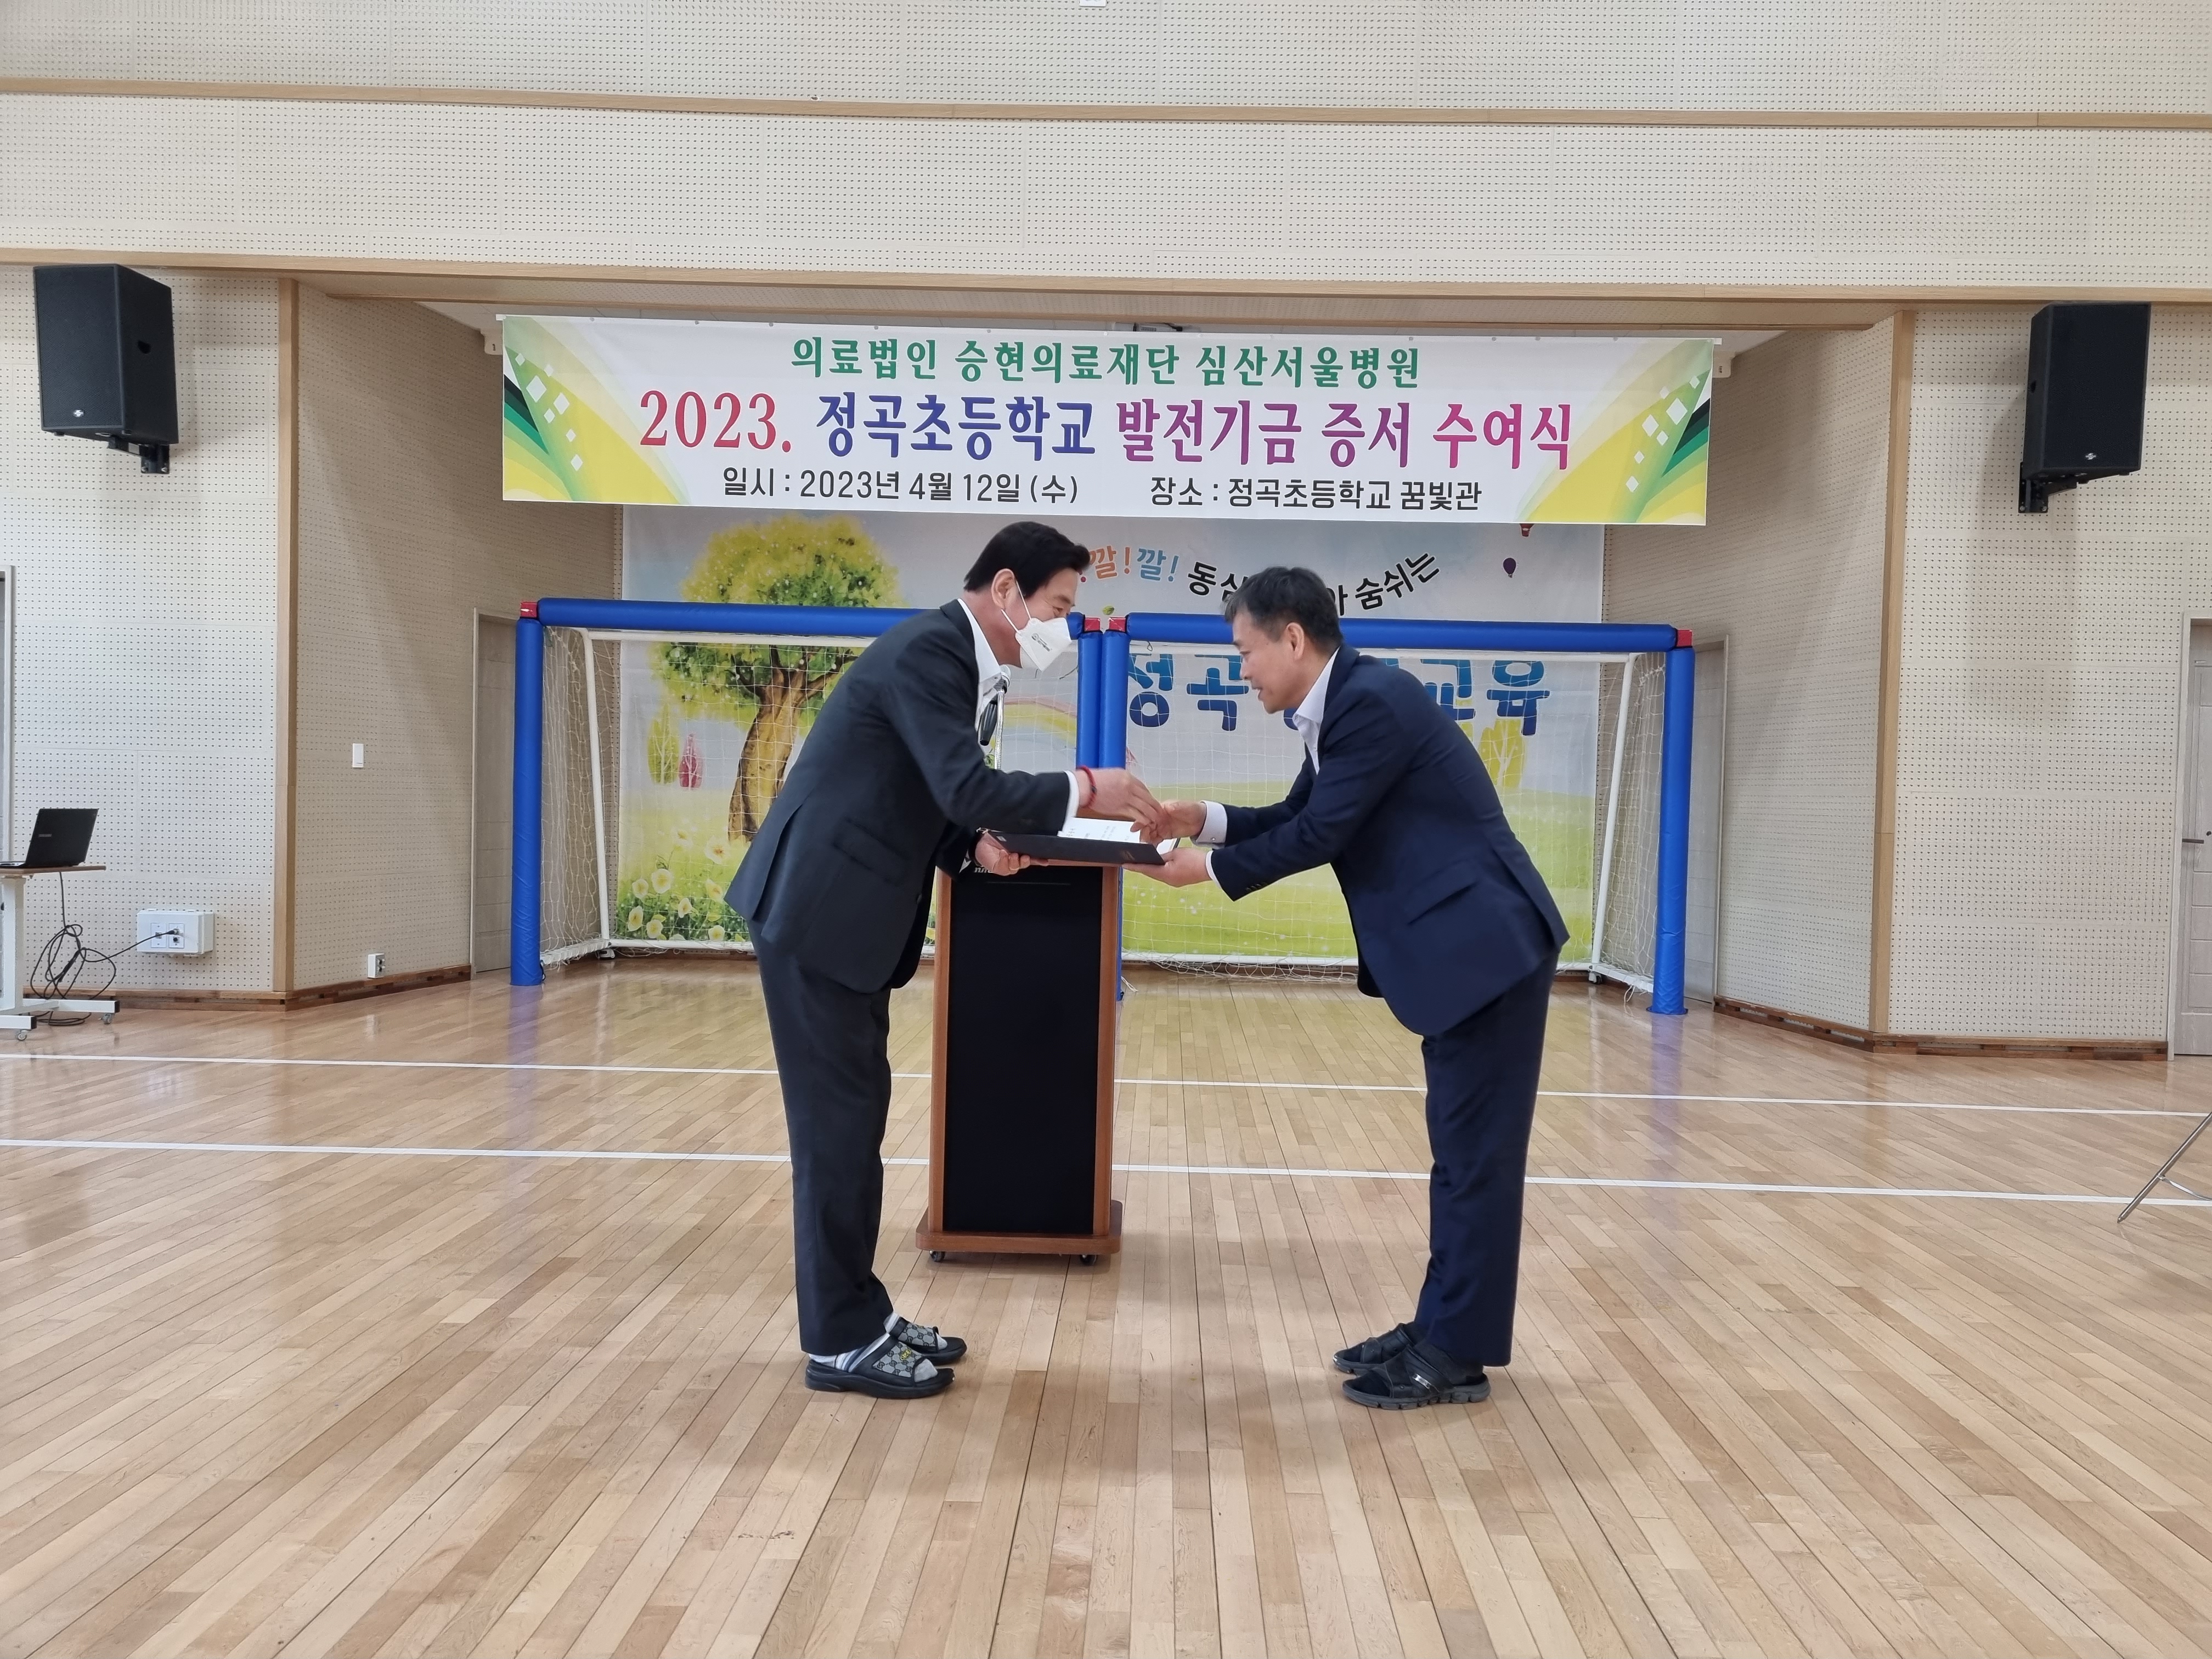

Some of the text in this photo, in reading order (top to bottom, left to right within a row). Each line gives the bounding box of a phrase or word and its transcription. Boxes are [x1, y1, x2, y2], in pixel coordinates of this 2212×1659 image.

[791, 337, 1419, 389] 의료법인 승현의료재단 심산서울병원
[640, 390, 1571, 470] 2023. 정곡초등학교 발전기금 증서 수여식
[723, 467, 774, 496] 일시
[800, 470, 899, 500] 2023년
[909, 472, 952, 501] 4월
[963, 473, 1019, 503] 12일
[1030, 475, 1078, 504] (수)
[1150, 477, 1203, 506] 장소
[1228, 478, 1391, 509] 정곡초등학교
[1400, 481, 1482, 511] 꿈빛관
[1355, 553, 1440, 610] 숨쉬는
